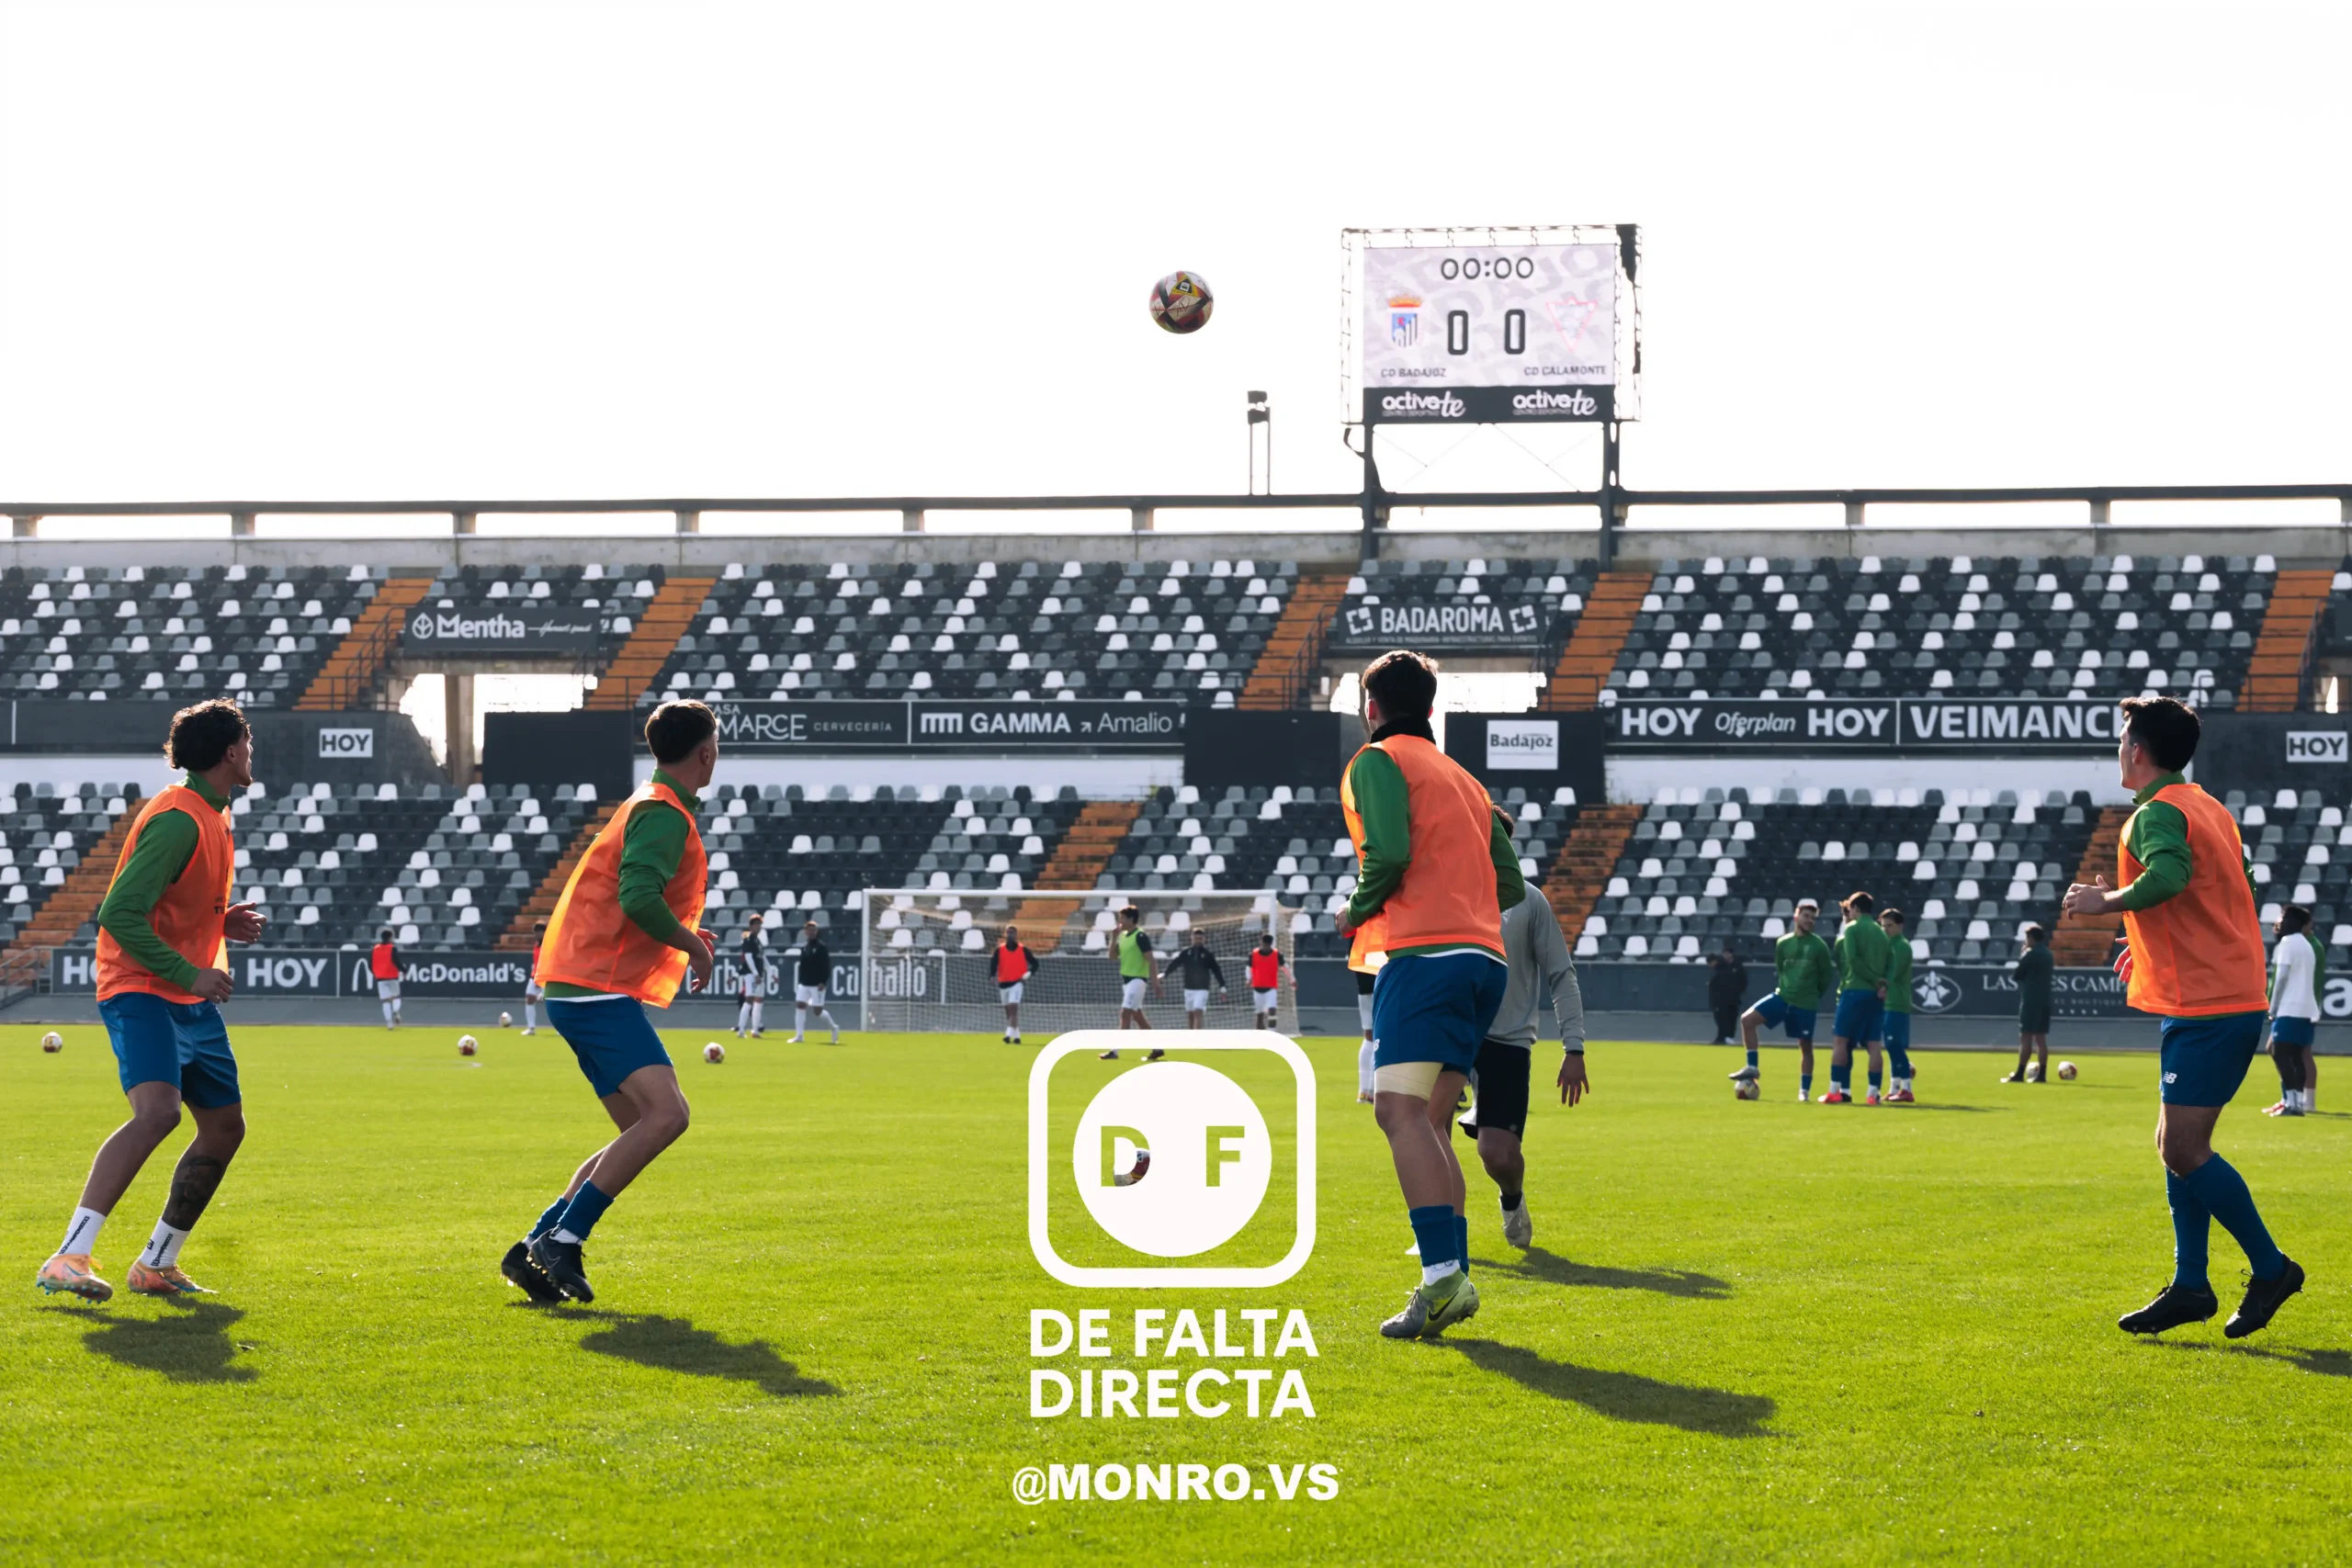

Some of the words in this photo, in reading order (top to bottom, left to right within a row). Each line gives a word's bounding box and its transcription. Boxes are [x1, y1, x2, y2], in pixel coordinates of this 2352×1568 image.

[1441, 257, 1534, 280] 00:00
[1447, 310, 1469, 355] 0
[1504, 309, 1526, 355] 0
[1542, 366, 1607, 377] CALAMONTE
[436, 613, 526, 638] Mentha
[1381, 605, 1504, 634] BADAROMA
[969, 713, 1071, 734] GAMMA
[1097, 712, 1173, 733] Amalio
[1622, 707, 1702, 736] HOY
[1714, 712, 1796, 738] Oferplan
[1807, 707, 1890, 737] HOY
[322, 734, 370, 752] HOY
[1490, 734, 1554, 750] Badajoz
[2288, 737, 2345, 756] HOY
[247, 957, 328, 987] HOY
